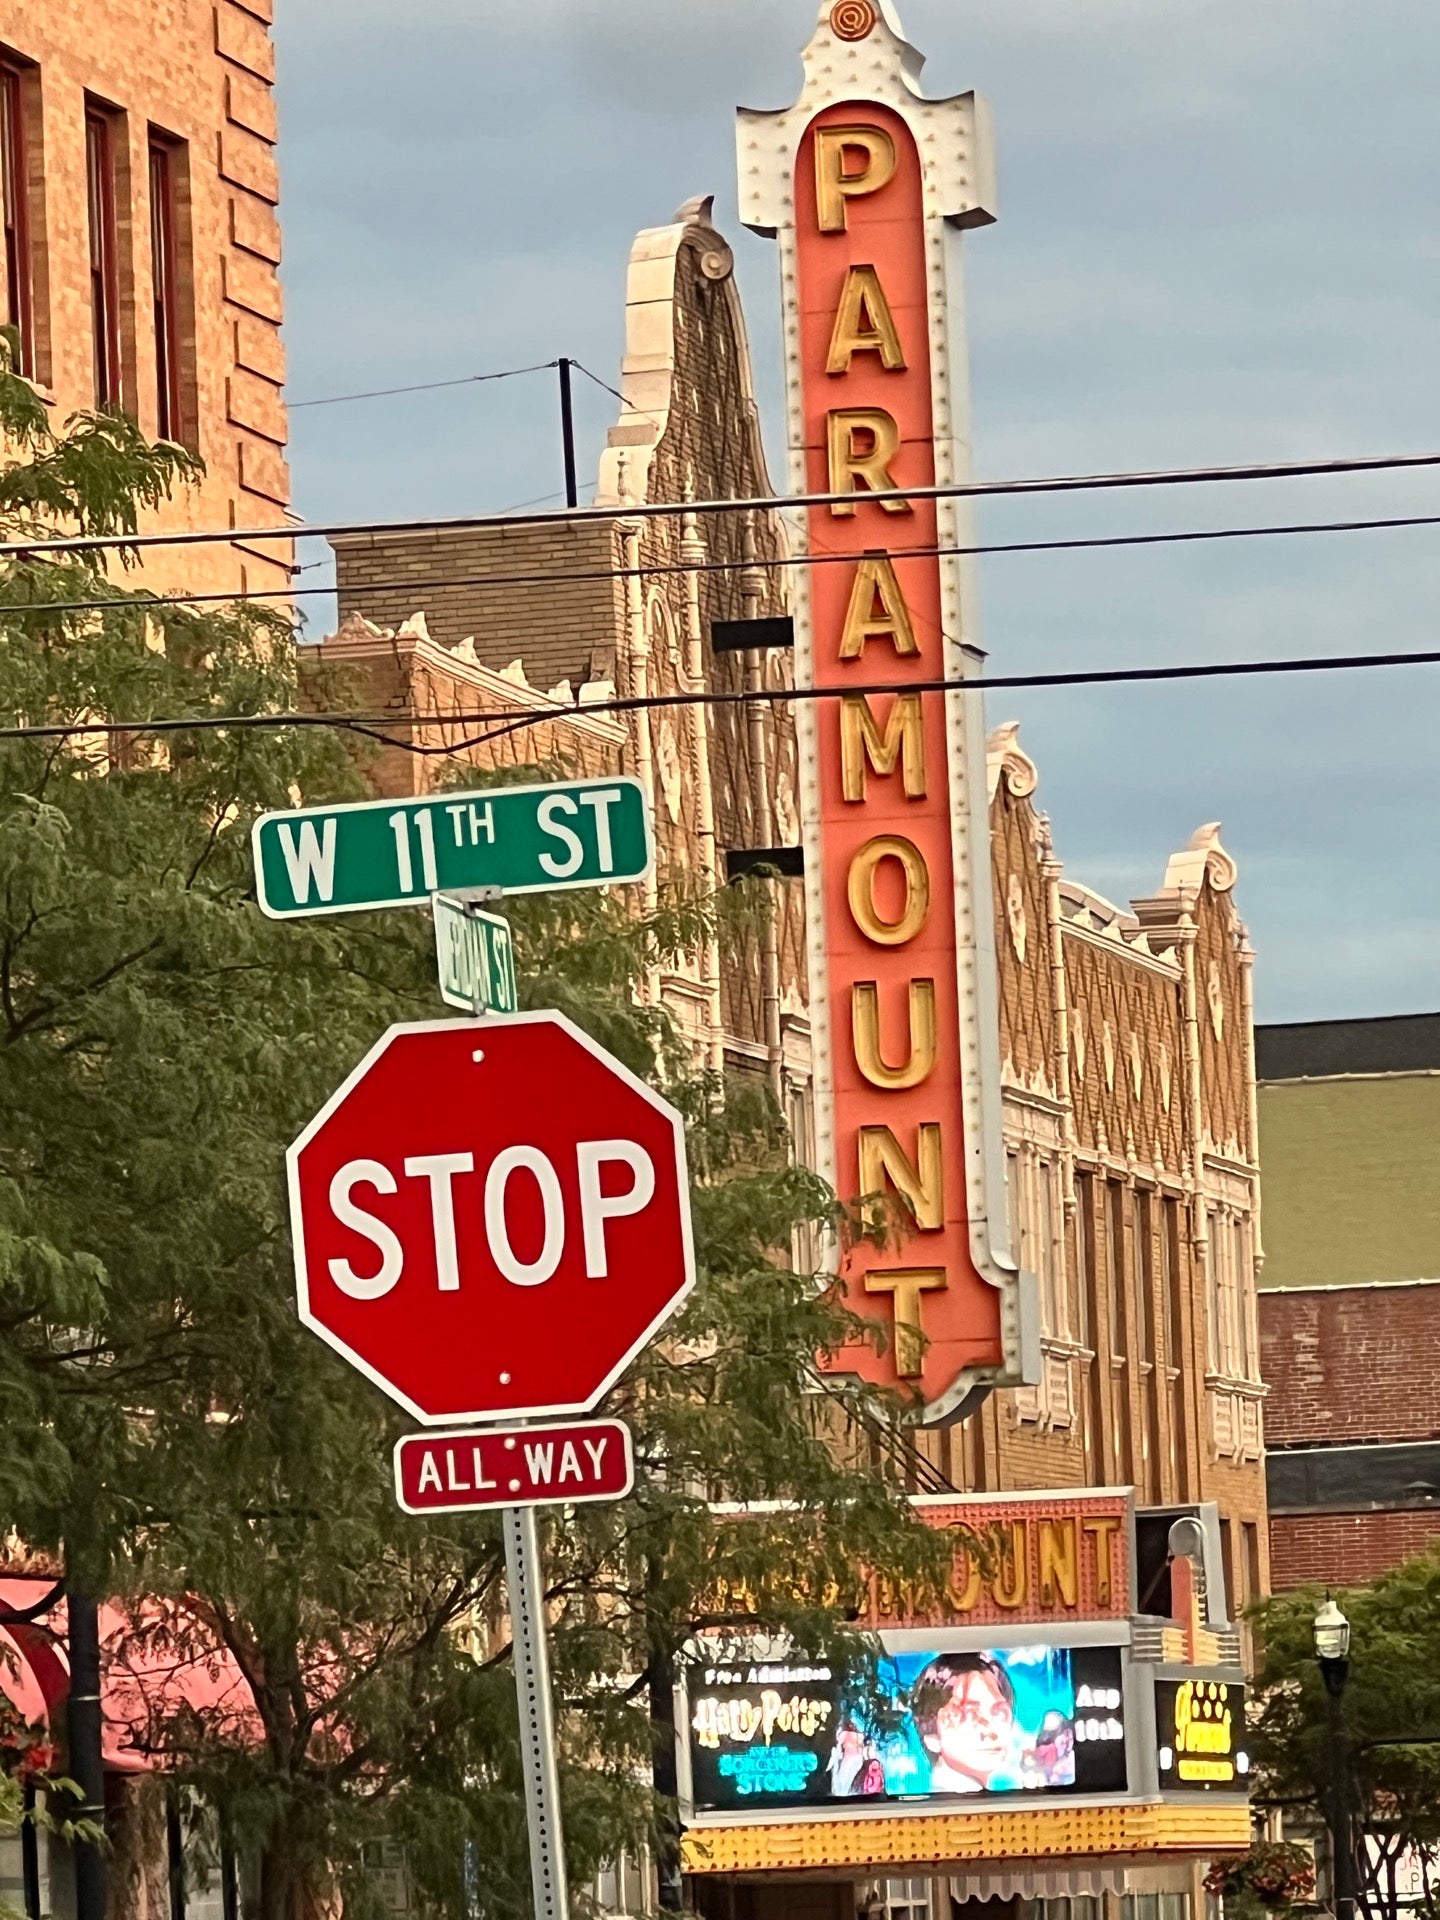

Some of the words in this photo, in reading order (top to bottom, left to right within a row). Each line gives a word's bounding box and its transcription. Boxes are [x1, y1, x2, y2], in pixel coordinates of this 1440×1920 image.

[813, 122, 948, 1379] PARAMOUNT
[277, 818, 338, 904] W
[536, 789, 622, 878] ST
[328, 1139, 656, 1300] STOP
[418, 1447, 497, 1494] ALL
[524, 1438, 608, 1486] WAY
